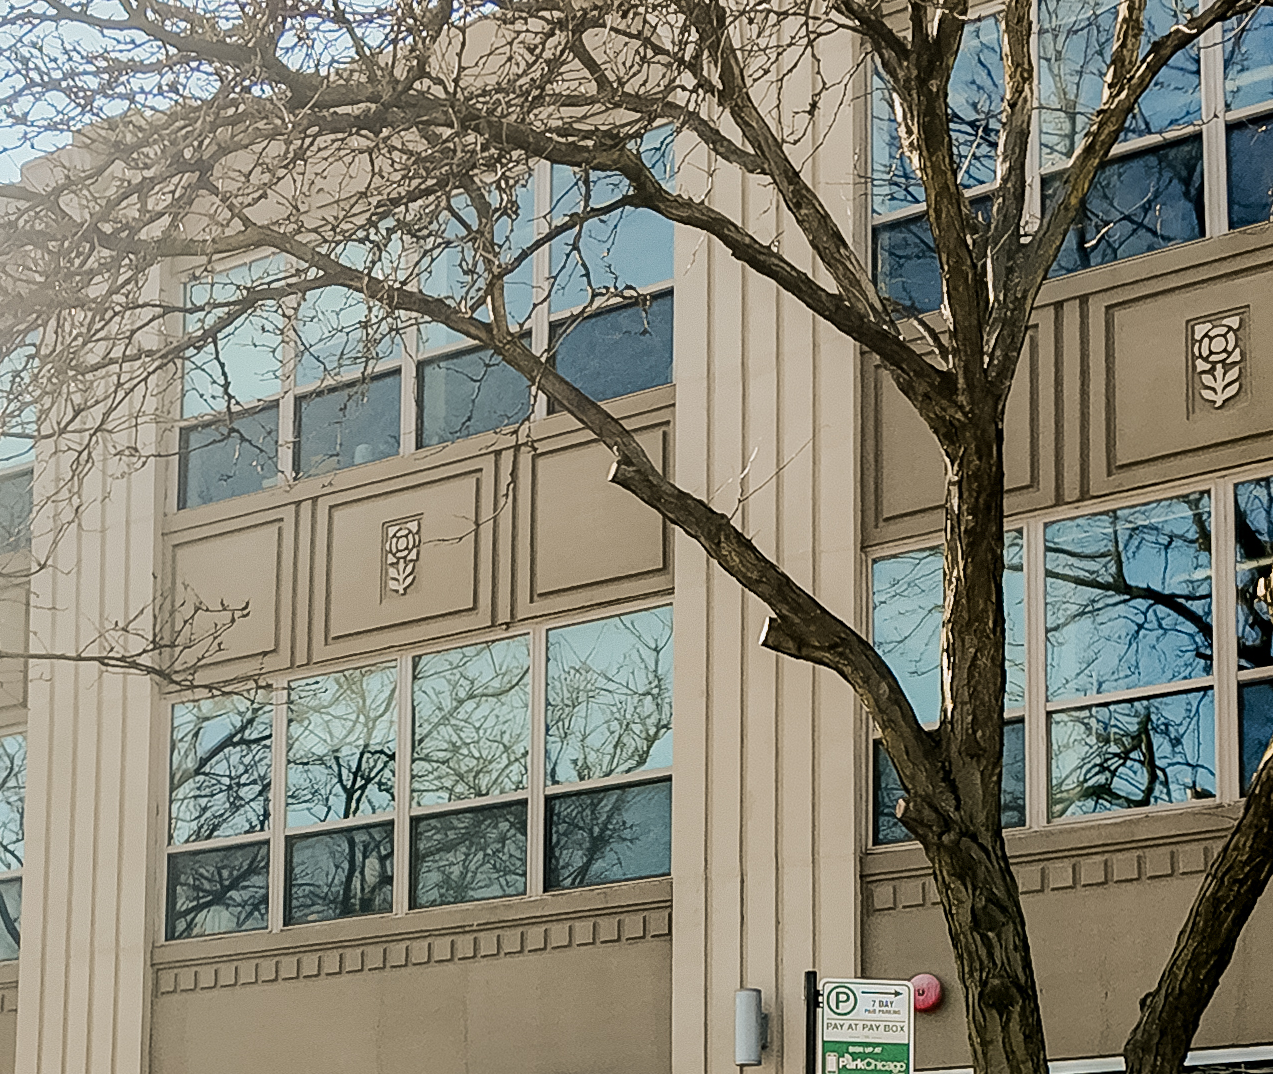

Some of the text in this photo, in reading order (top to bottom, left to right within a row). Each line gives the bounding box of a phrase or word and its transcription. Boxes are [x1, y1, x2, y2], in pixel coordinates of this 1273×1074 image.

[836, 991, 850, 1010] P
[878, 1000, 894, 1008] DAY
[826, 1022, 906, 1033] PAY AT PAY BOX
